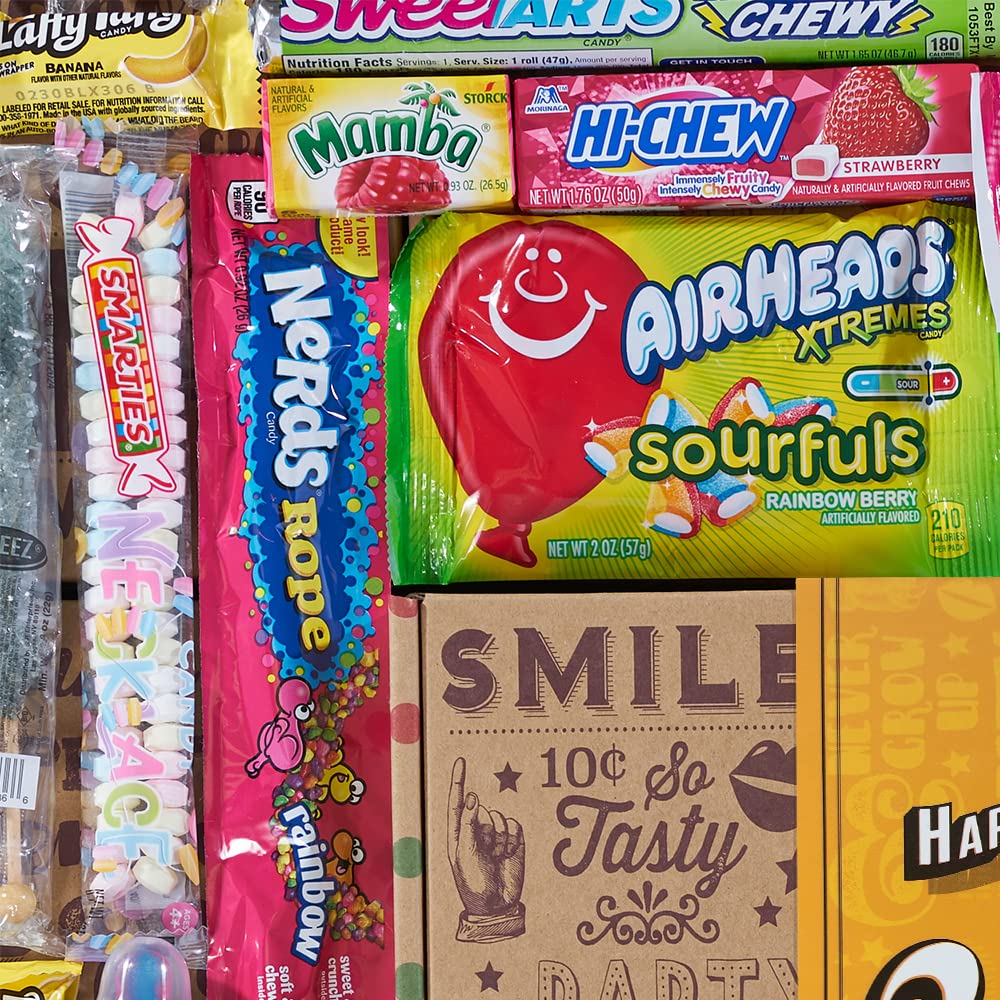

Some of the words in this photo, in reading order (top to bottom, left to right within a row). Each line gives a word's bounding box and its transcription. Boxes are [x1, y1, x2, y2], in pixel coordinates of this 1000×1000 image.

[730, 1, 908, 37] CHEWY
[101, 26, 132, 38] CANDY
[930, 37, 958, 51] 180
[46, 61, 104, 74] BANANA
[288, 58, 351, 68] Nutrition
[355, 57, 392, 67] Facts
[464, 92, 508, 104] STORCK
[527, 104, 568, 112] MORINAGA
[295, 106, 478, 175] Mamba
[844, 158, 941, 173] STRAWBERRY
[660, 184, 701, 196] Intensely
[702, 182, 750, 199] Chewy
[751, 184, 781, 195] Candy
[676, 174, 725, 186] Immensely
[726, 172, 768, 185] Fruity
[793, 184, 832, 194] NATURALLY
[841, 181, 884, 193] ARTIFICIALLY
[886, 180, 922, 191] FLAVORED
[924, 179, 943, 189] FRUIT
[945, 178, 970, 188] CHEWS
[626, 218, 944, 375] AIRHEADS
[796, 303, 950, 361] XTREMES
[97, 266, 154, 446] SMARTIES
[635, 419, 919, 478] sourfuls
[766, 492, 857, 509] RAINBOW
[862, 491, 917, 507] BERRY
[930, 508, 963, 531] 210
[281, 497, 330, 652] Rope
[441, 624, 796, 718] SMILE
[540, 743, 626, 789] 10¢
[644, 740, 715, 811] So
[553, 795, 747, 898] Tasty
[281, 804, 325, 964] rainbow
